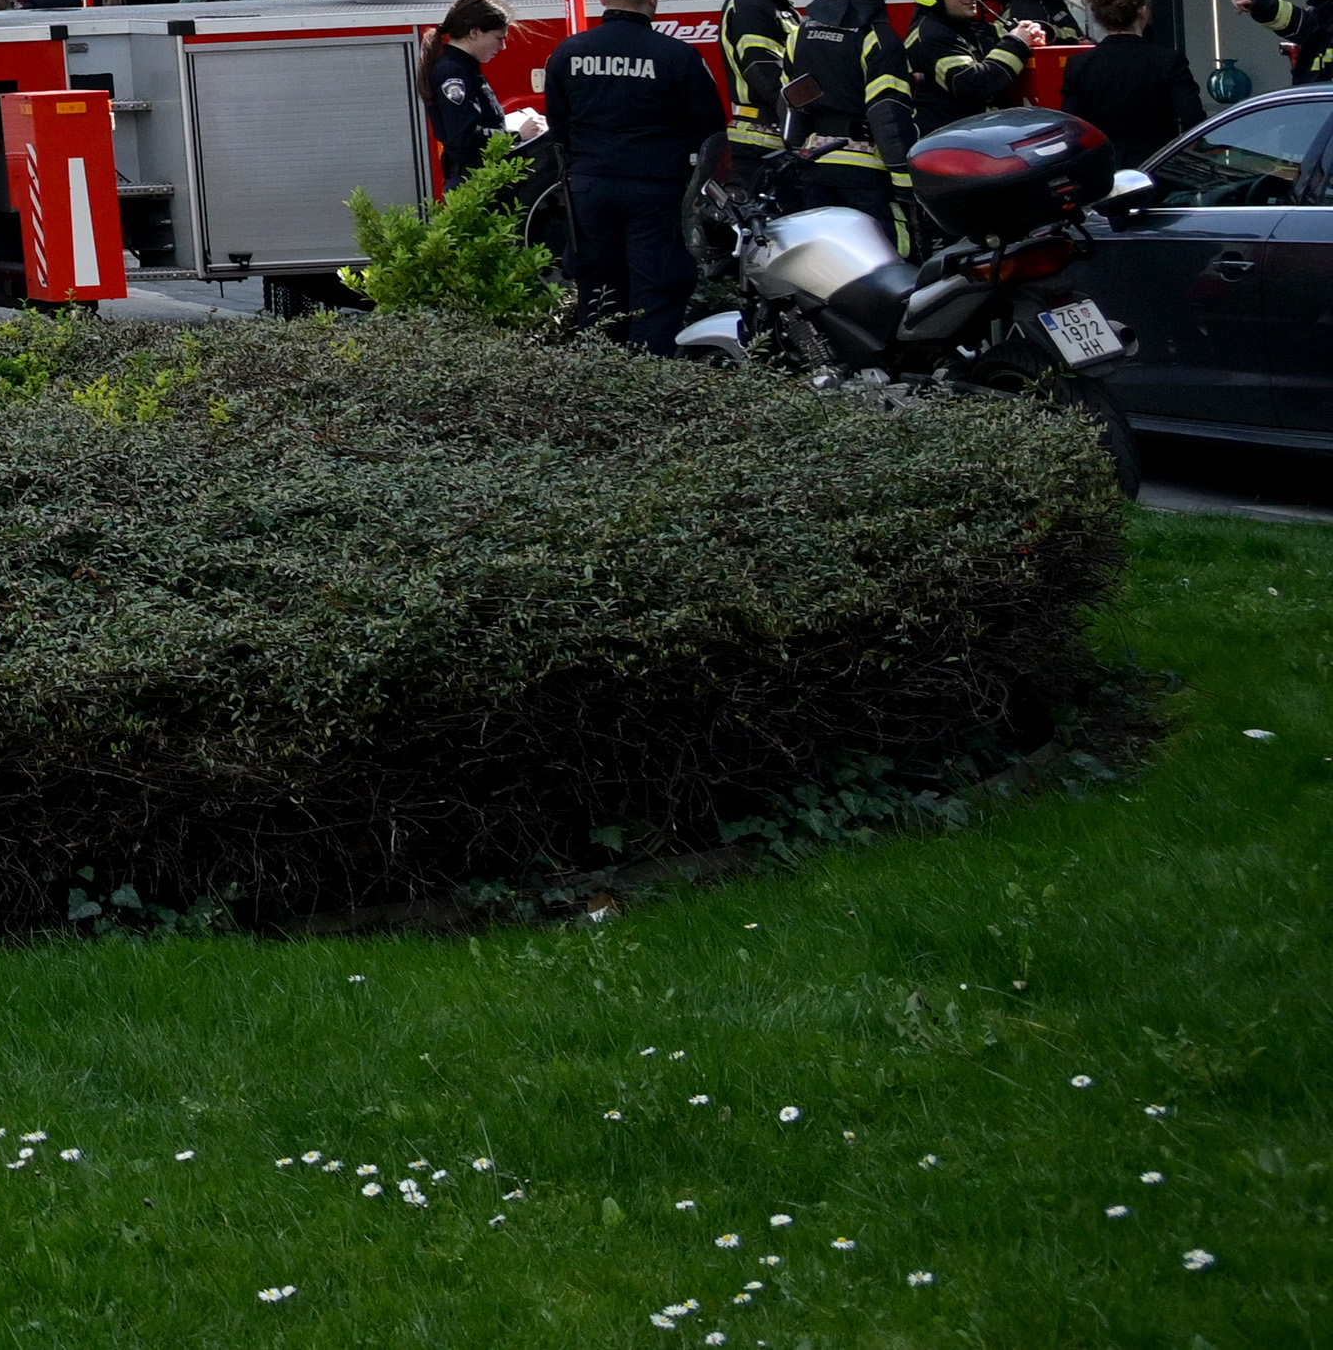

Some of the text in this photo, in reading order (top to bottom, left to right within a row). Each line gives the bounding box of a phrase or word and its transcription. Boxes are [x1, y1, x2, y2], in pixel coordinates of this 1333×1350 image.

[806, 30, 844, 42] ZAGREB
[570, 56, 656, 80] POLICIJA
[1055, 309, 1081, 328] ZG
[1060, 320, 1105, 345] 1972
[1078, 338, 1105, 357] HH
